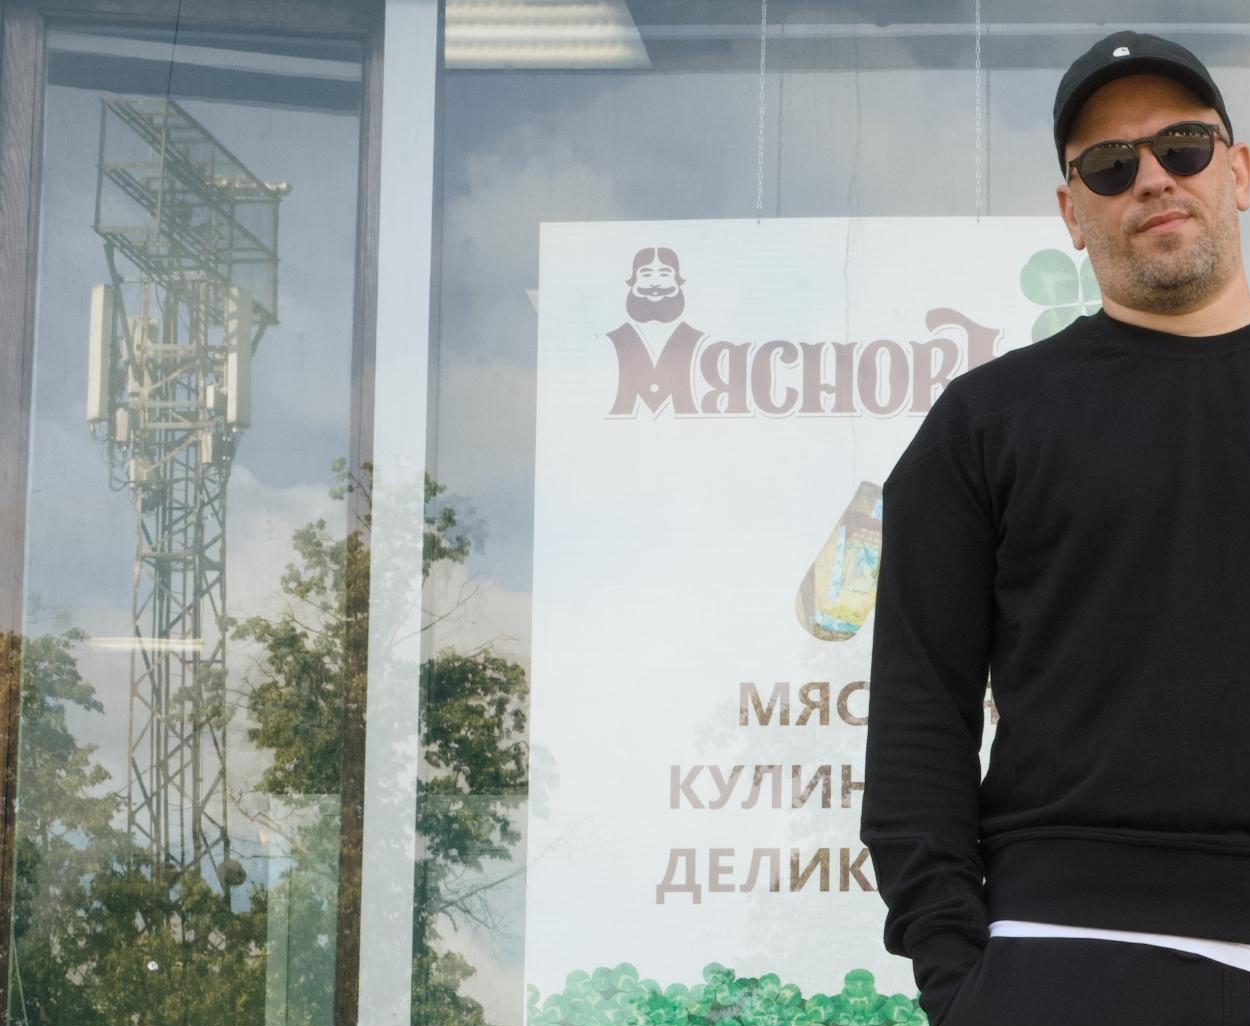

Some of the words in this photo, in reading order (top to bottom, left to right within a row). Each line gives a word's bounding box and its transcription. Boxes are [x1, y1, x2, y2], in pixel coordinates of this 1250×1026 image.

[738, 680, 870, 727] МЯС
[668, 763, 866, 810] КУЛИН
[655, 847, 879, 905] ДЕЛИК
